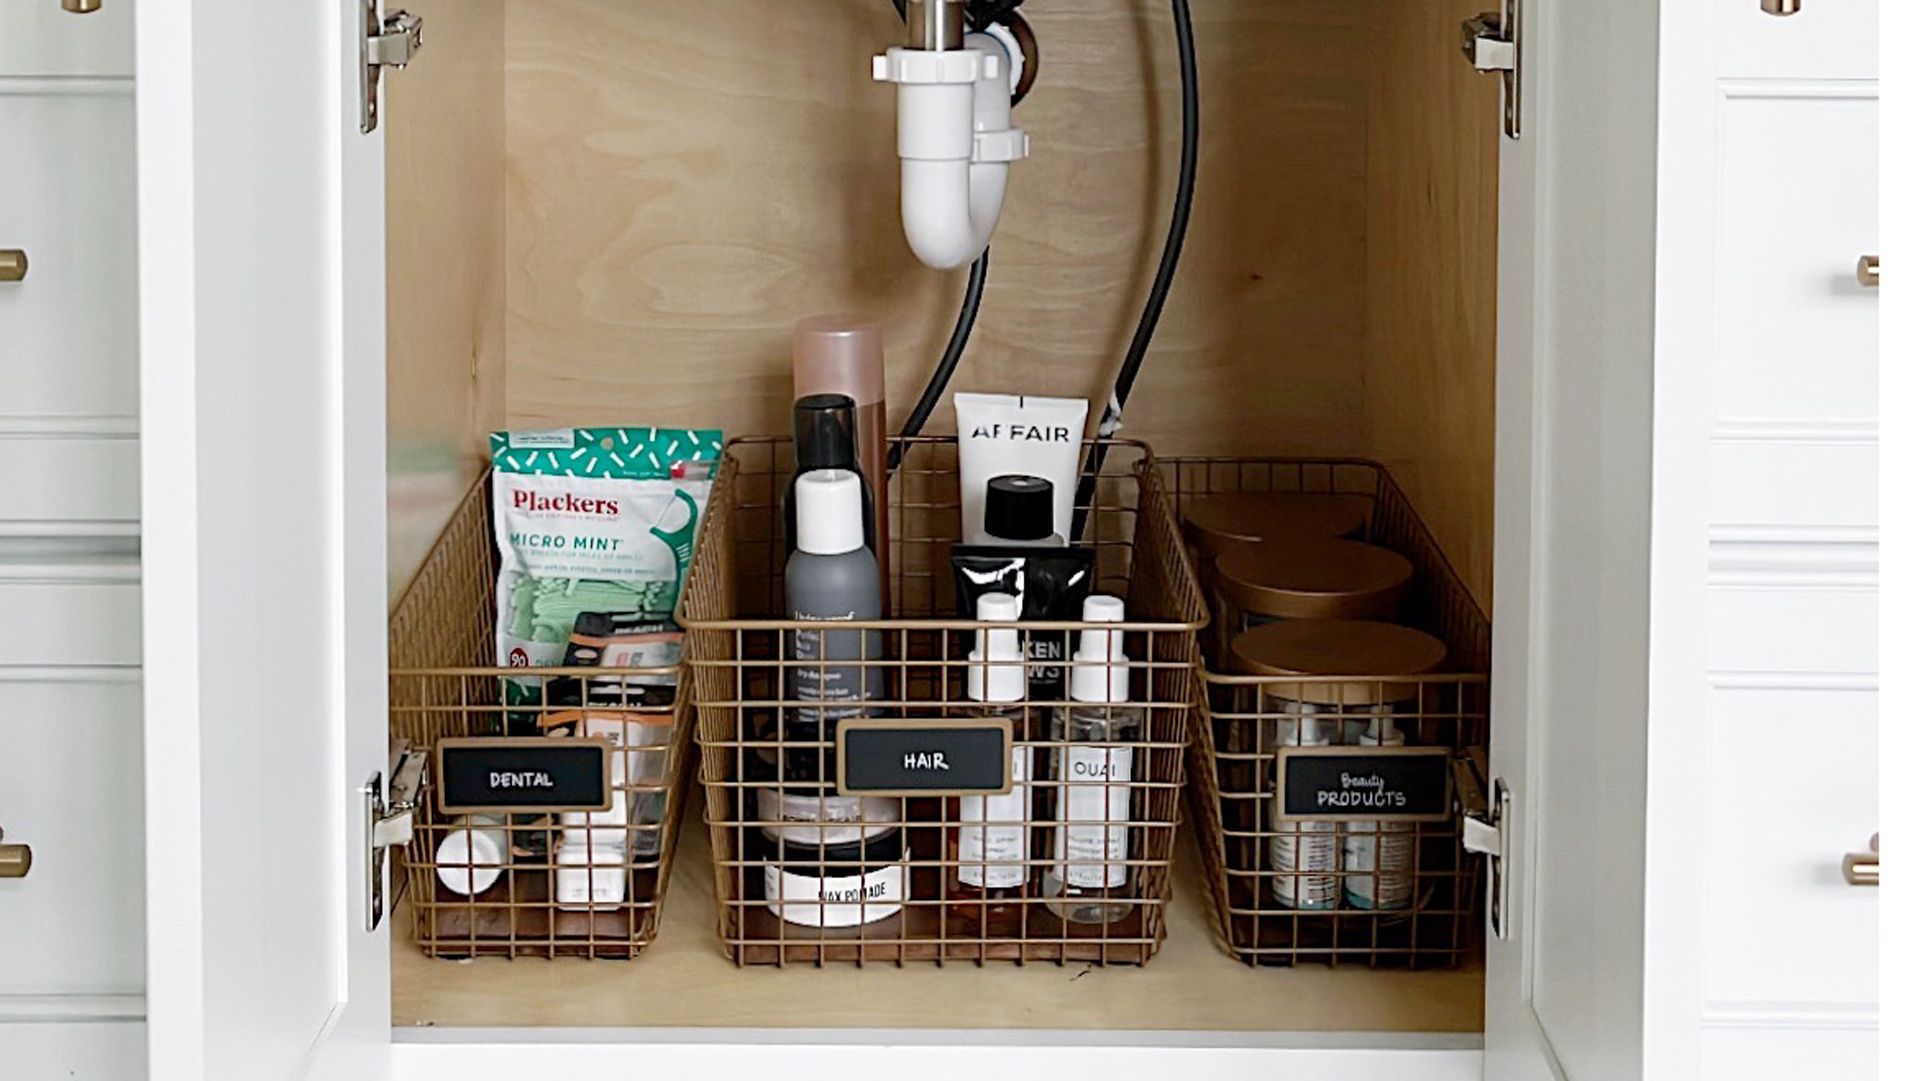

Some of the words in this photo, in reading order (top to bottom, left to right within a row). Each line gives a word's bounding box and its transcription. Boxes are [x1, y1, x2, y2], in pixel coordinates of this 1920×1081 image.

[513, 489, 619, 515] Plackers
[510, 533, 566, 548] MICRO
[573, 537, 620, 550] MINT
[510, 652, 526, 667] 90
[904, 752, 950, 771] HAIR
[490, 772, 554, 788] DENTAL
[1341, 772, 1385, 793] Beauty
[1317, 791, 1407, 806] PRODUCTS
